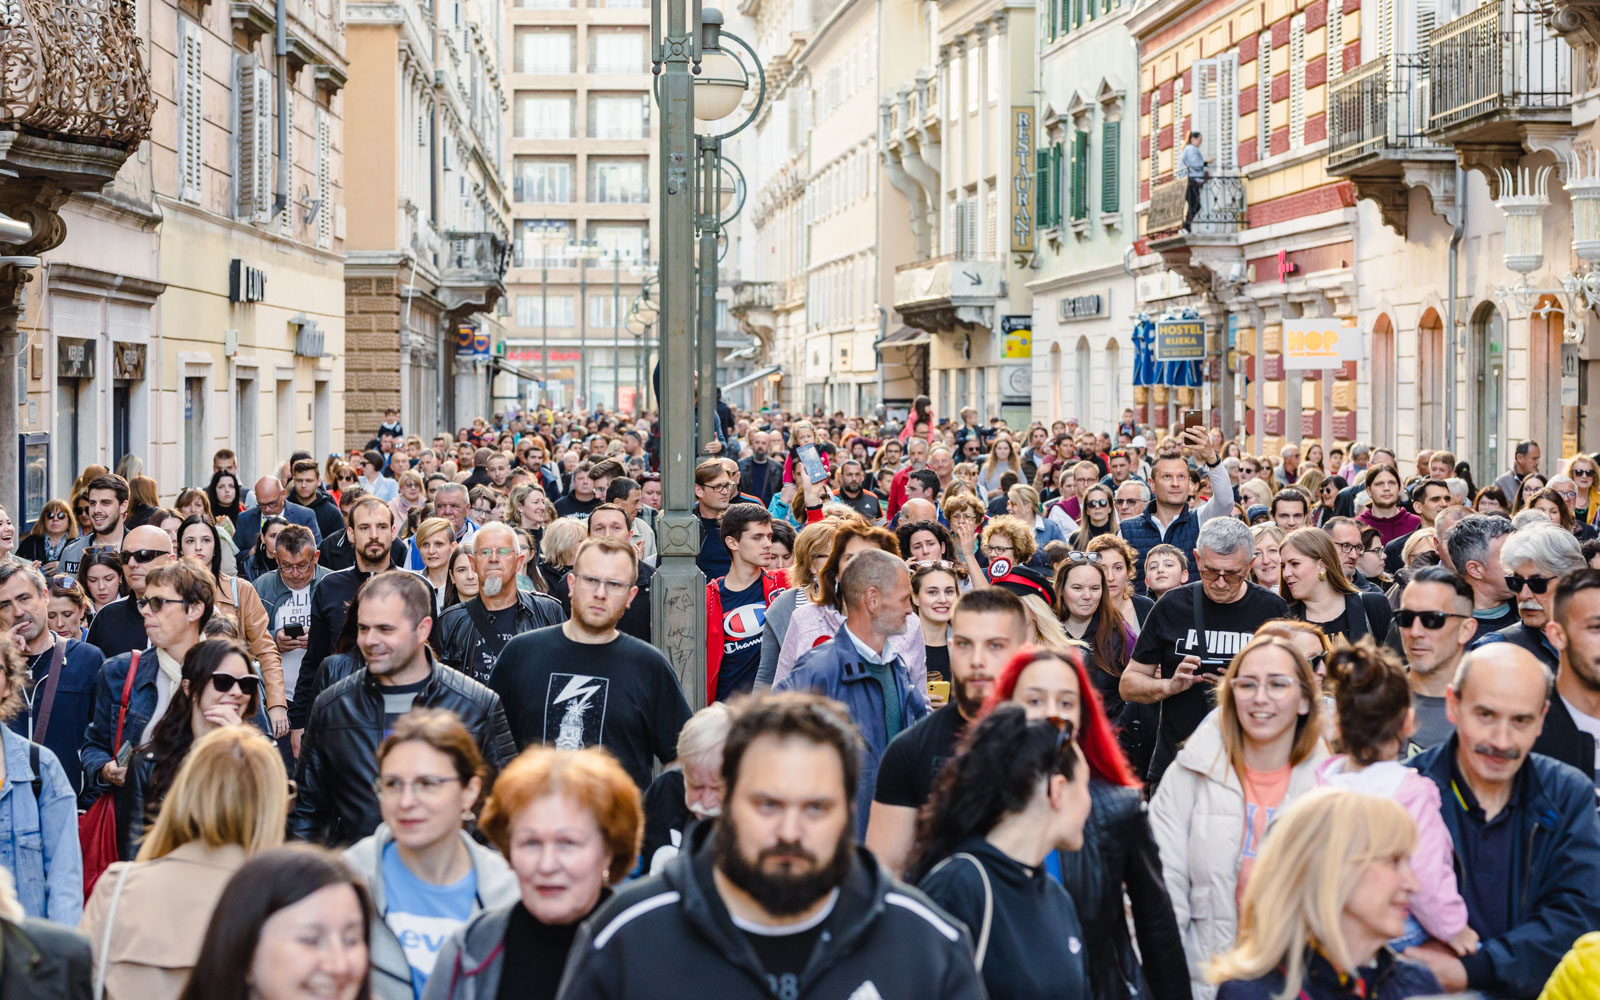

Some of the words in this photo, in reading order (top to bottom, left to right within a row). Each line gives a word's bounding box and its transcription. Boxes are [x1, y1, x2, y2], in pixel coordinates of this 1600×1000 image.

[1015, 111, 1031, 246] RESTAURANT
[1159, 324, 1203, 335] HOSTEL
[1165, 337, 1197, 345] RIJEKA
[1288, 330, 1339, 351] HOP
